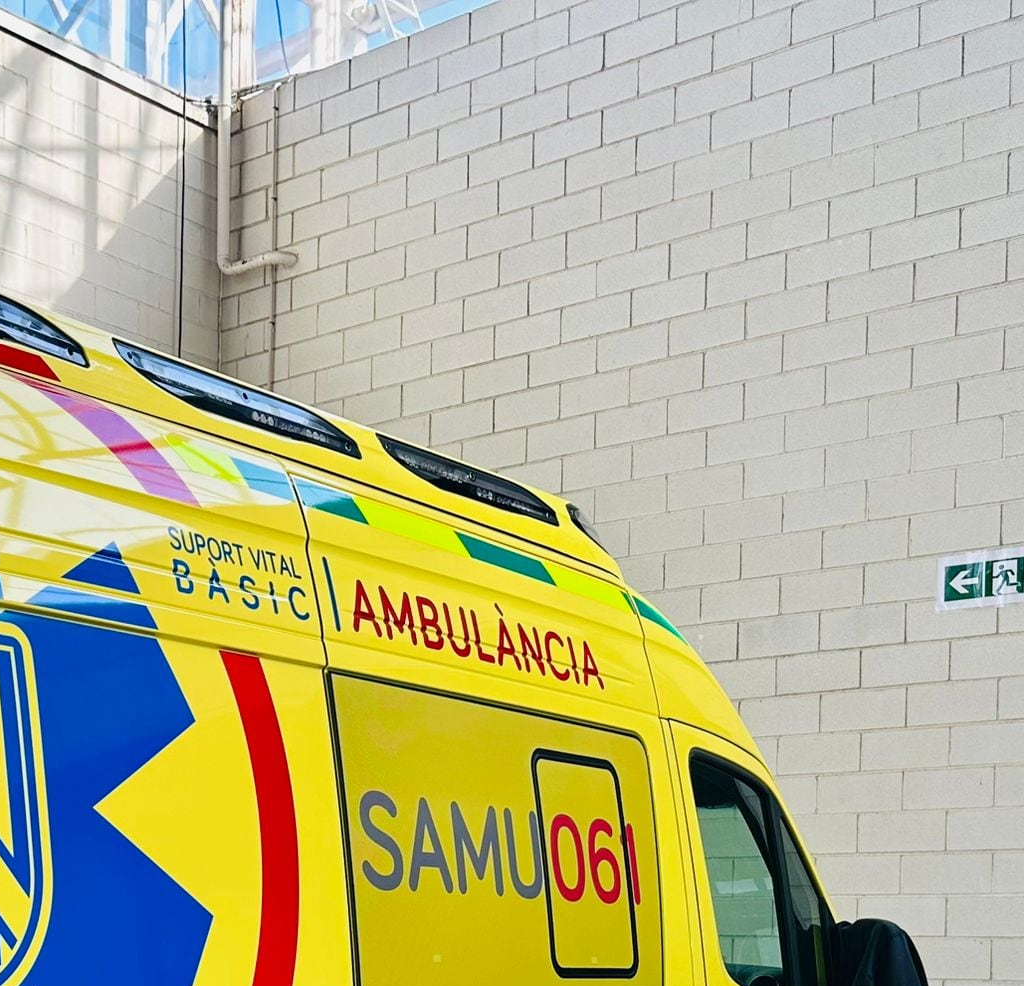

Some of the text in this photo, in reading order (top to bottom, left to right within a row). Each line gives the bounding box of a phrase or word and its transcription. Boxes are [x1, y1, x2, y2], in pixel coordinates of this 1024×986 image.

[167, 526, 302, 580] SUPORT VITAL
[172, 557, 310, 621] BÀSIC
[352, 580, 606, 690] AMBULÀNCIA
